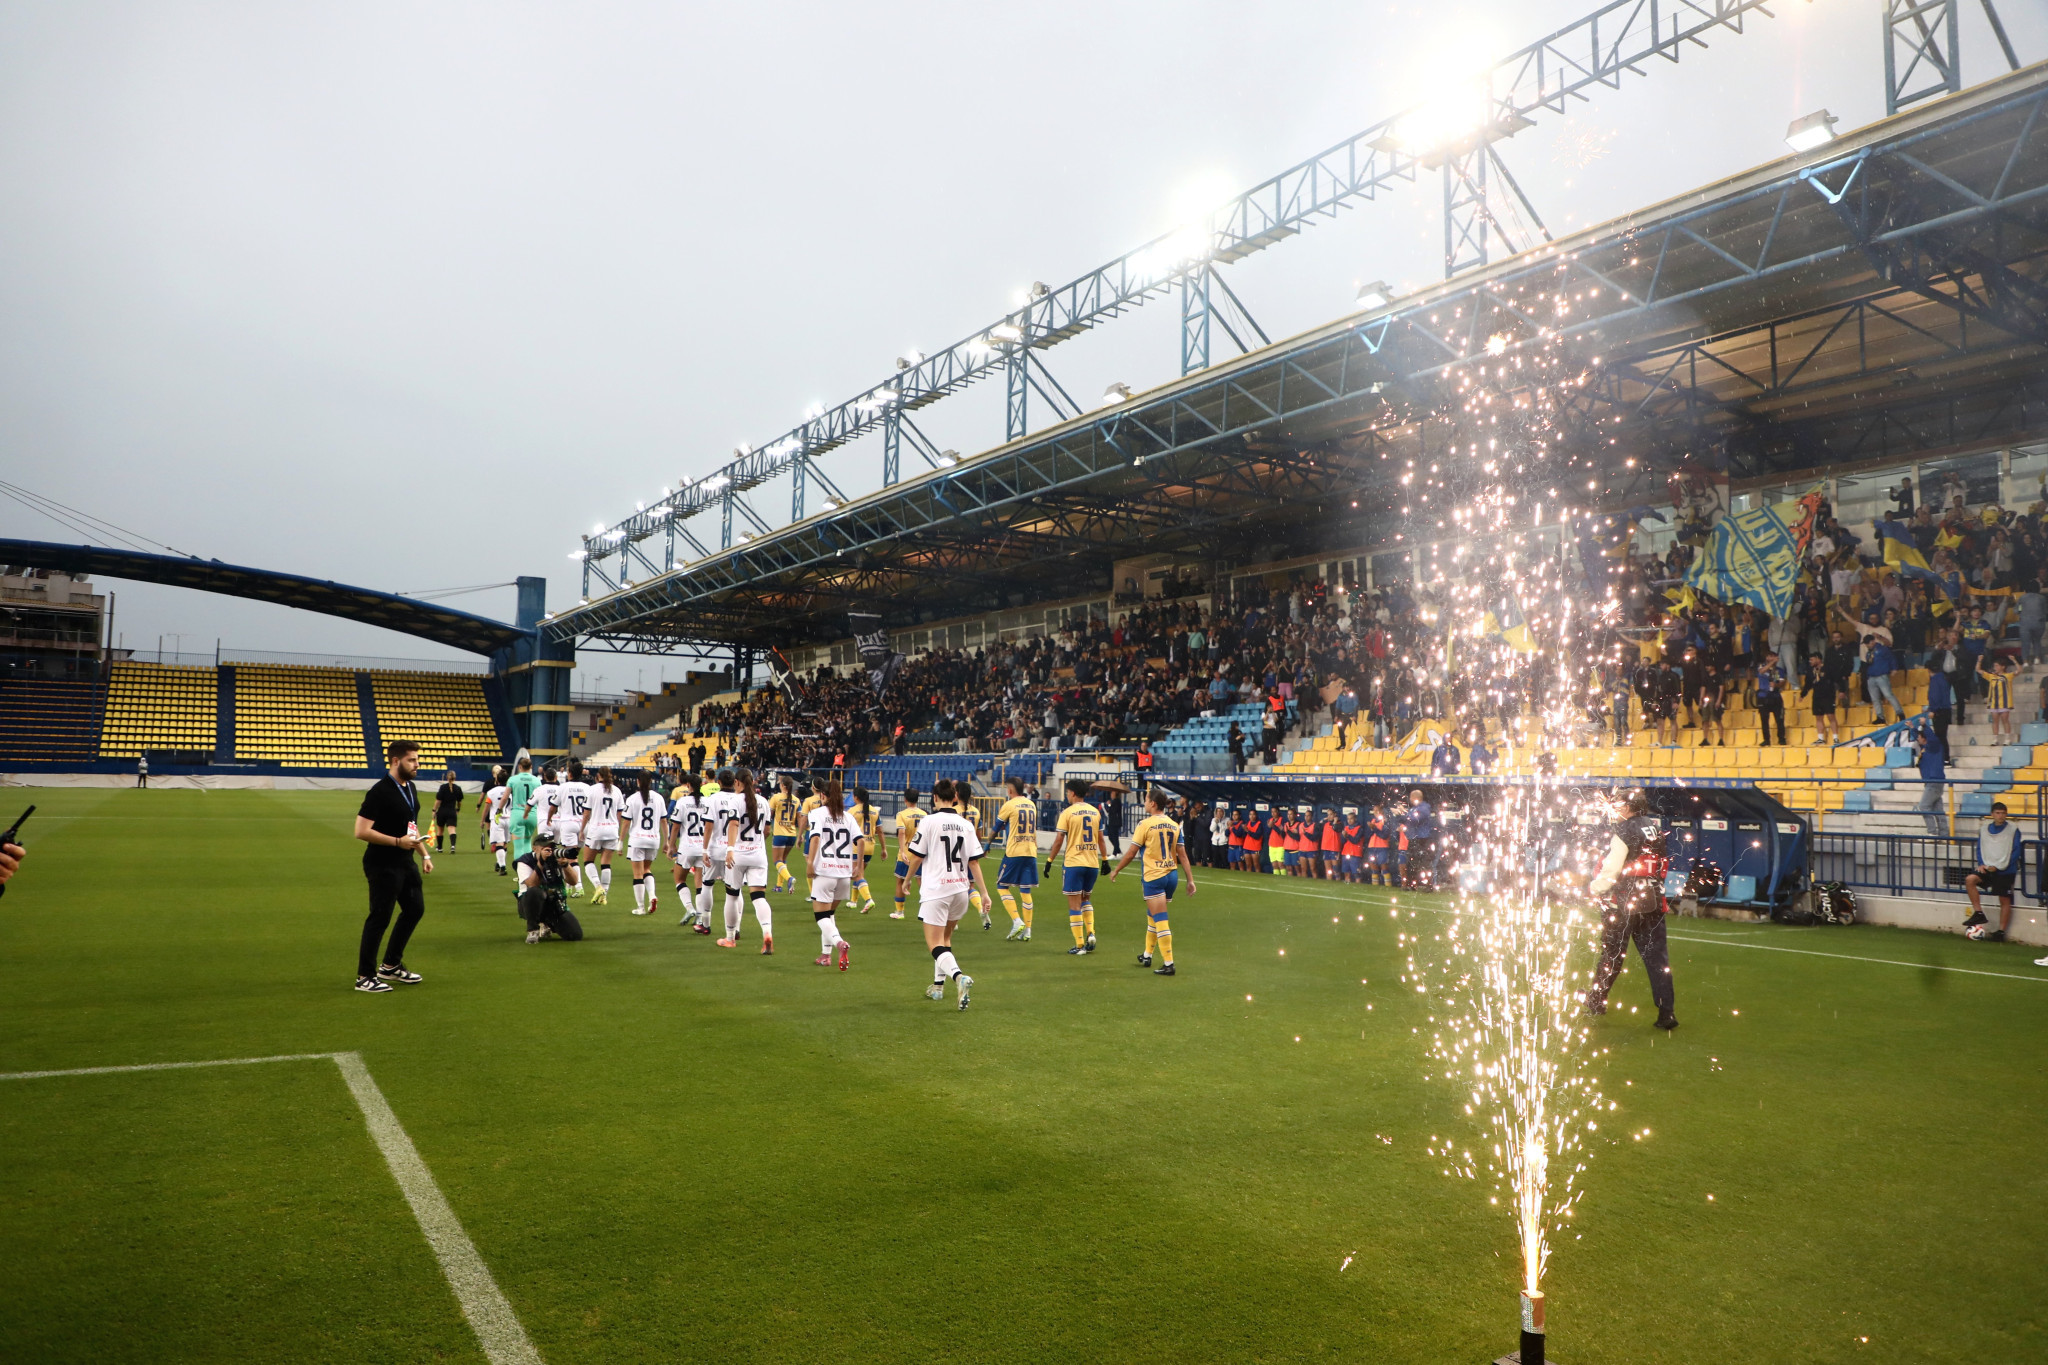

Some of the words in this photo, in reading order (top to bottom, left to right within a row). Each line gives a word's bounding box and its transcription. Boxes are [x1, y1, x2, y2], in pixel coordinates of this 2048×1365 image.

[568, 796, 584, 816] 18
[603, 797, 613, 819] 7
[781, 803, 795, 821] 27
[641, 807, 653, 830] 8
[1018, 810, 1035, 834] 99
[1083, 816, 1093, 842] 5
[821, 827, 851, 859] 22
[940, 835, 964, 872] 14
[1159, 831, 1174, 860] 17
